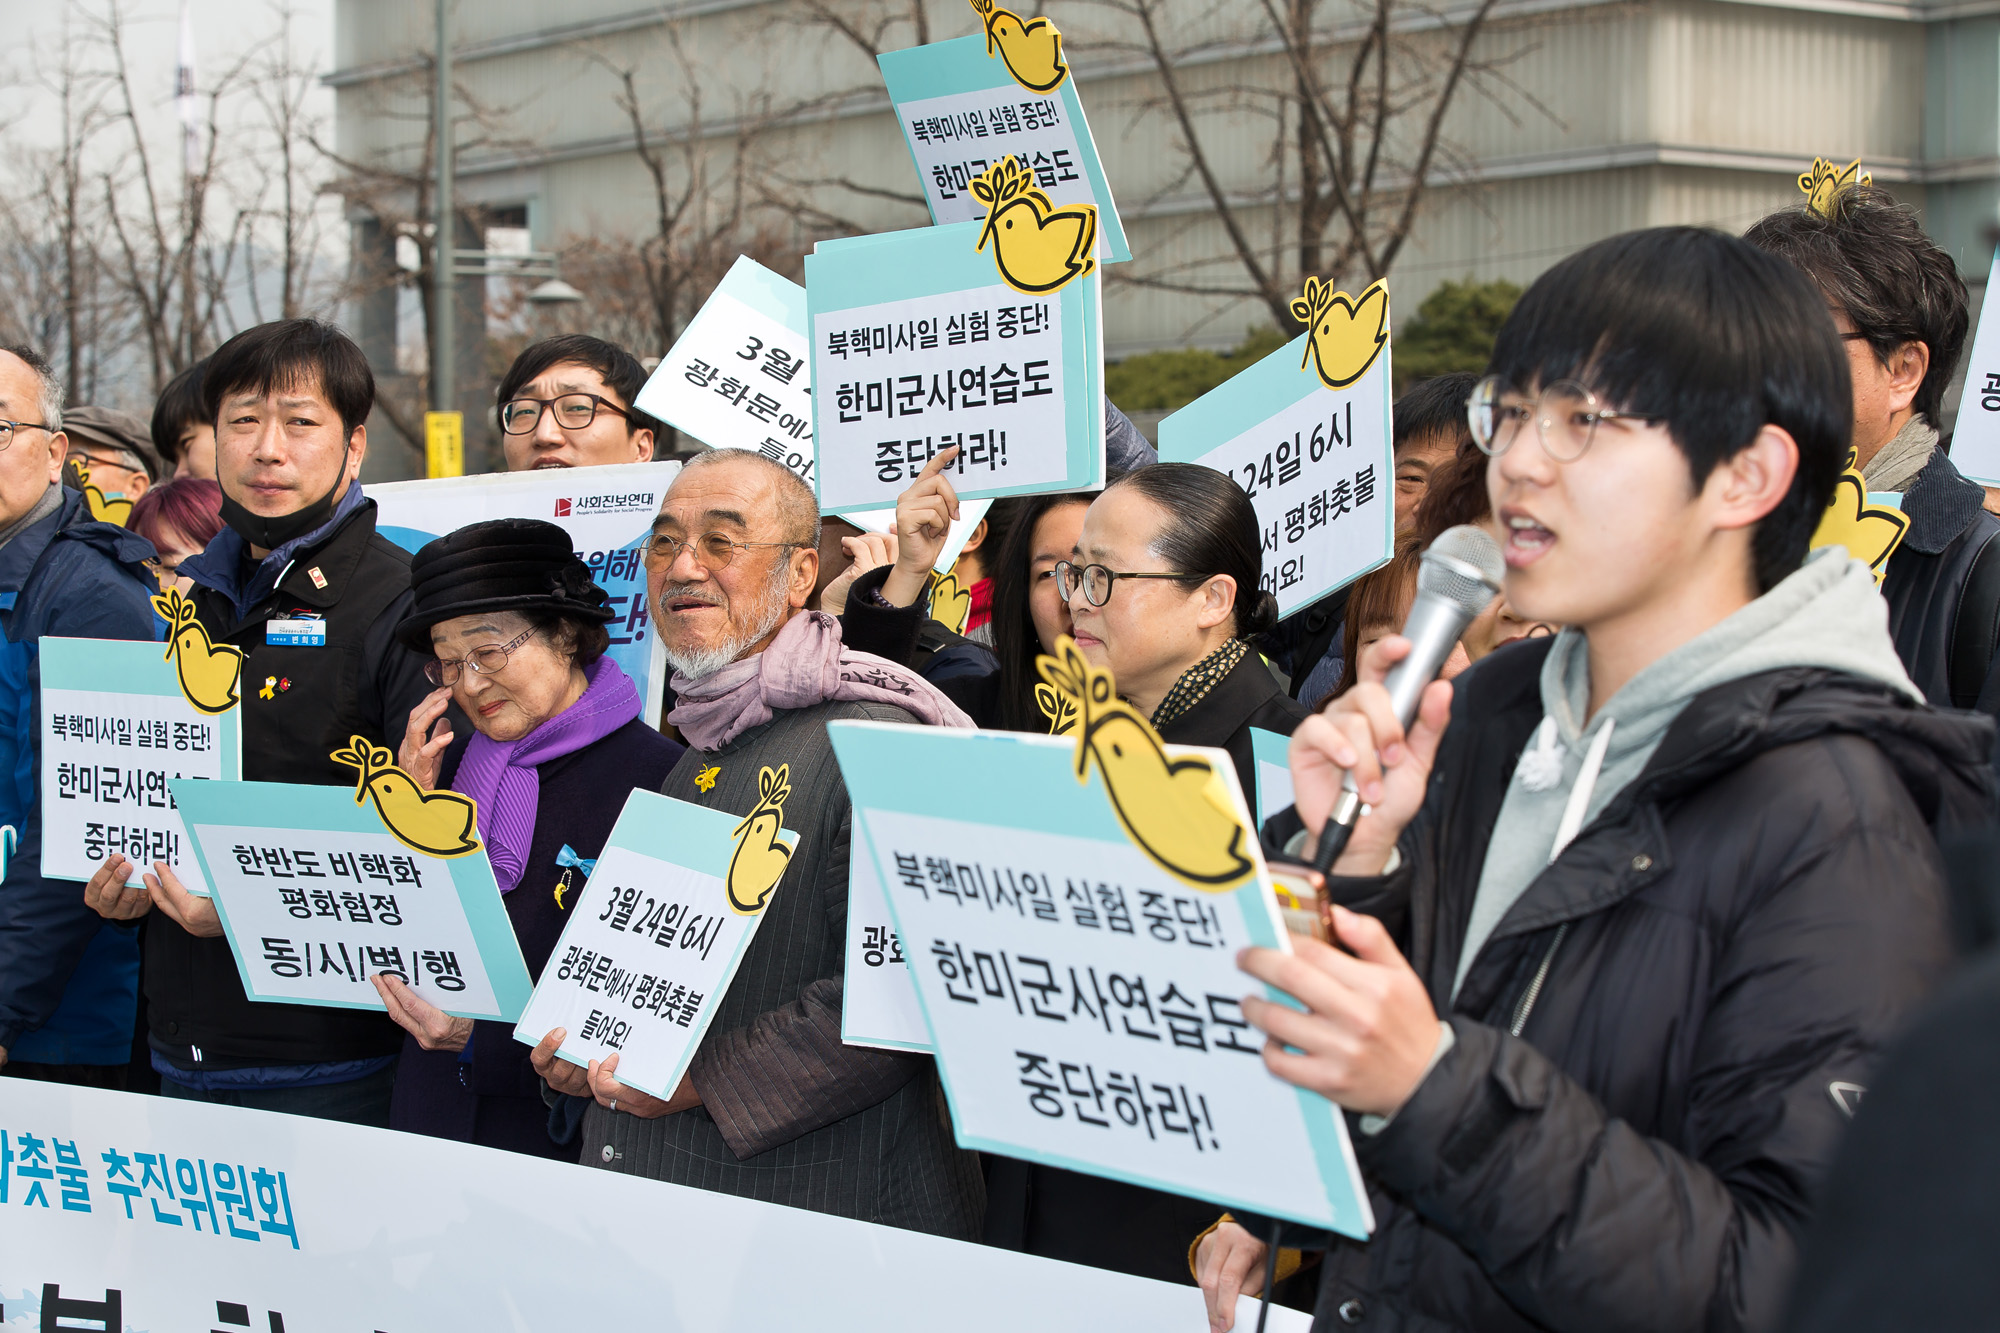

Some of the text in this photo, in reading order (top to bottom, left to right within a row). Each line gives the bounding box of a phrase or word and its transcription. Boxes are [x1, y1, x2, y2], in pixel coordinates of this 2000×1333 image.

[912, 99, 1060, 145] 북핵미사일 실험 중단!
[827, 302, 1050, 360] 북핵미사일 실험 중단!
[735, 335, 805, 386] 3월
[684, 358, 814, 440] 광화문에
[835, 359, 1054, 423] 한미군사연습도
[757, 436, 815, 481] 들어
[874, 428, 1008, 483] 중단하라!
[1243, 401, 1352, 500] 24일 6시
[575, 492, 654, 508] 사회진보연대
[1284, 463, 1376, 544] 평화촛불
[588, 549, 642, 583] 위해
[52, 713, 211, 751] 북핵미사일 실험 중단!
[57, 762, 210, 810] 한미군사연
[84, 822, 179, 867] 중단하라!
[232, 844, 423, 888] 한반도 비핵화
[278, 887, 403, 926] 평화협정
[599, 886, 725, 961] 3월 24일 6시
[893, 849, 1228, 950] 북핵미사일 실험 중단!
[261, 936, 467, 992] 동/시/병/행
[557, 945, 704, 1029] 광화문에서 평화촛불
[930, 937, 1263, 1056] 한미군사연습도
[580, 1009, 632, 1051] 들어요!
[1014, 1048, 1222, 1152] 중단하라!
[100, 1147, 301, 1250] 추진위원회
